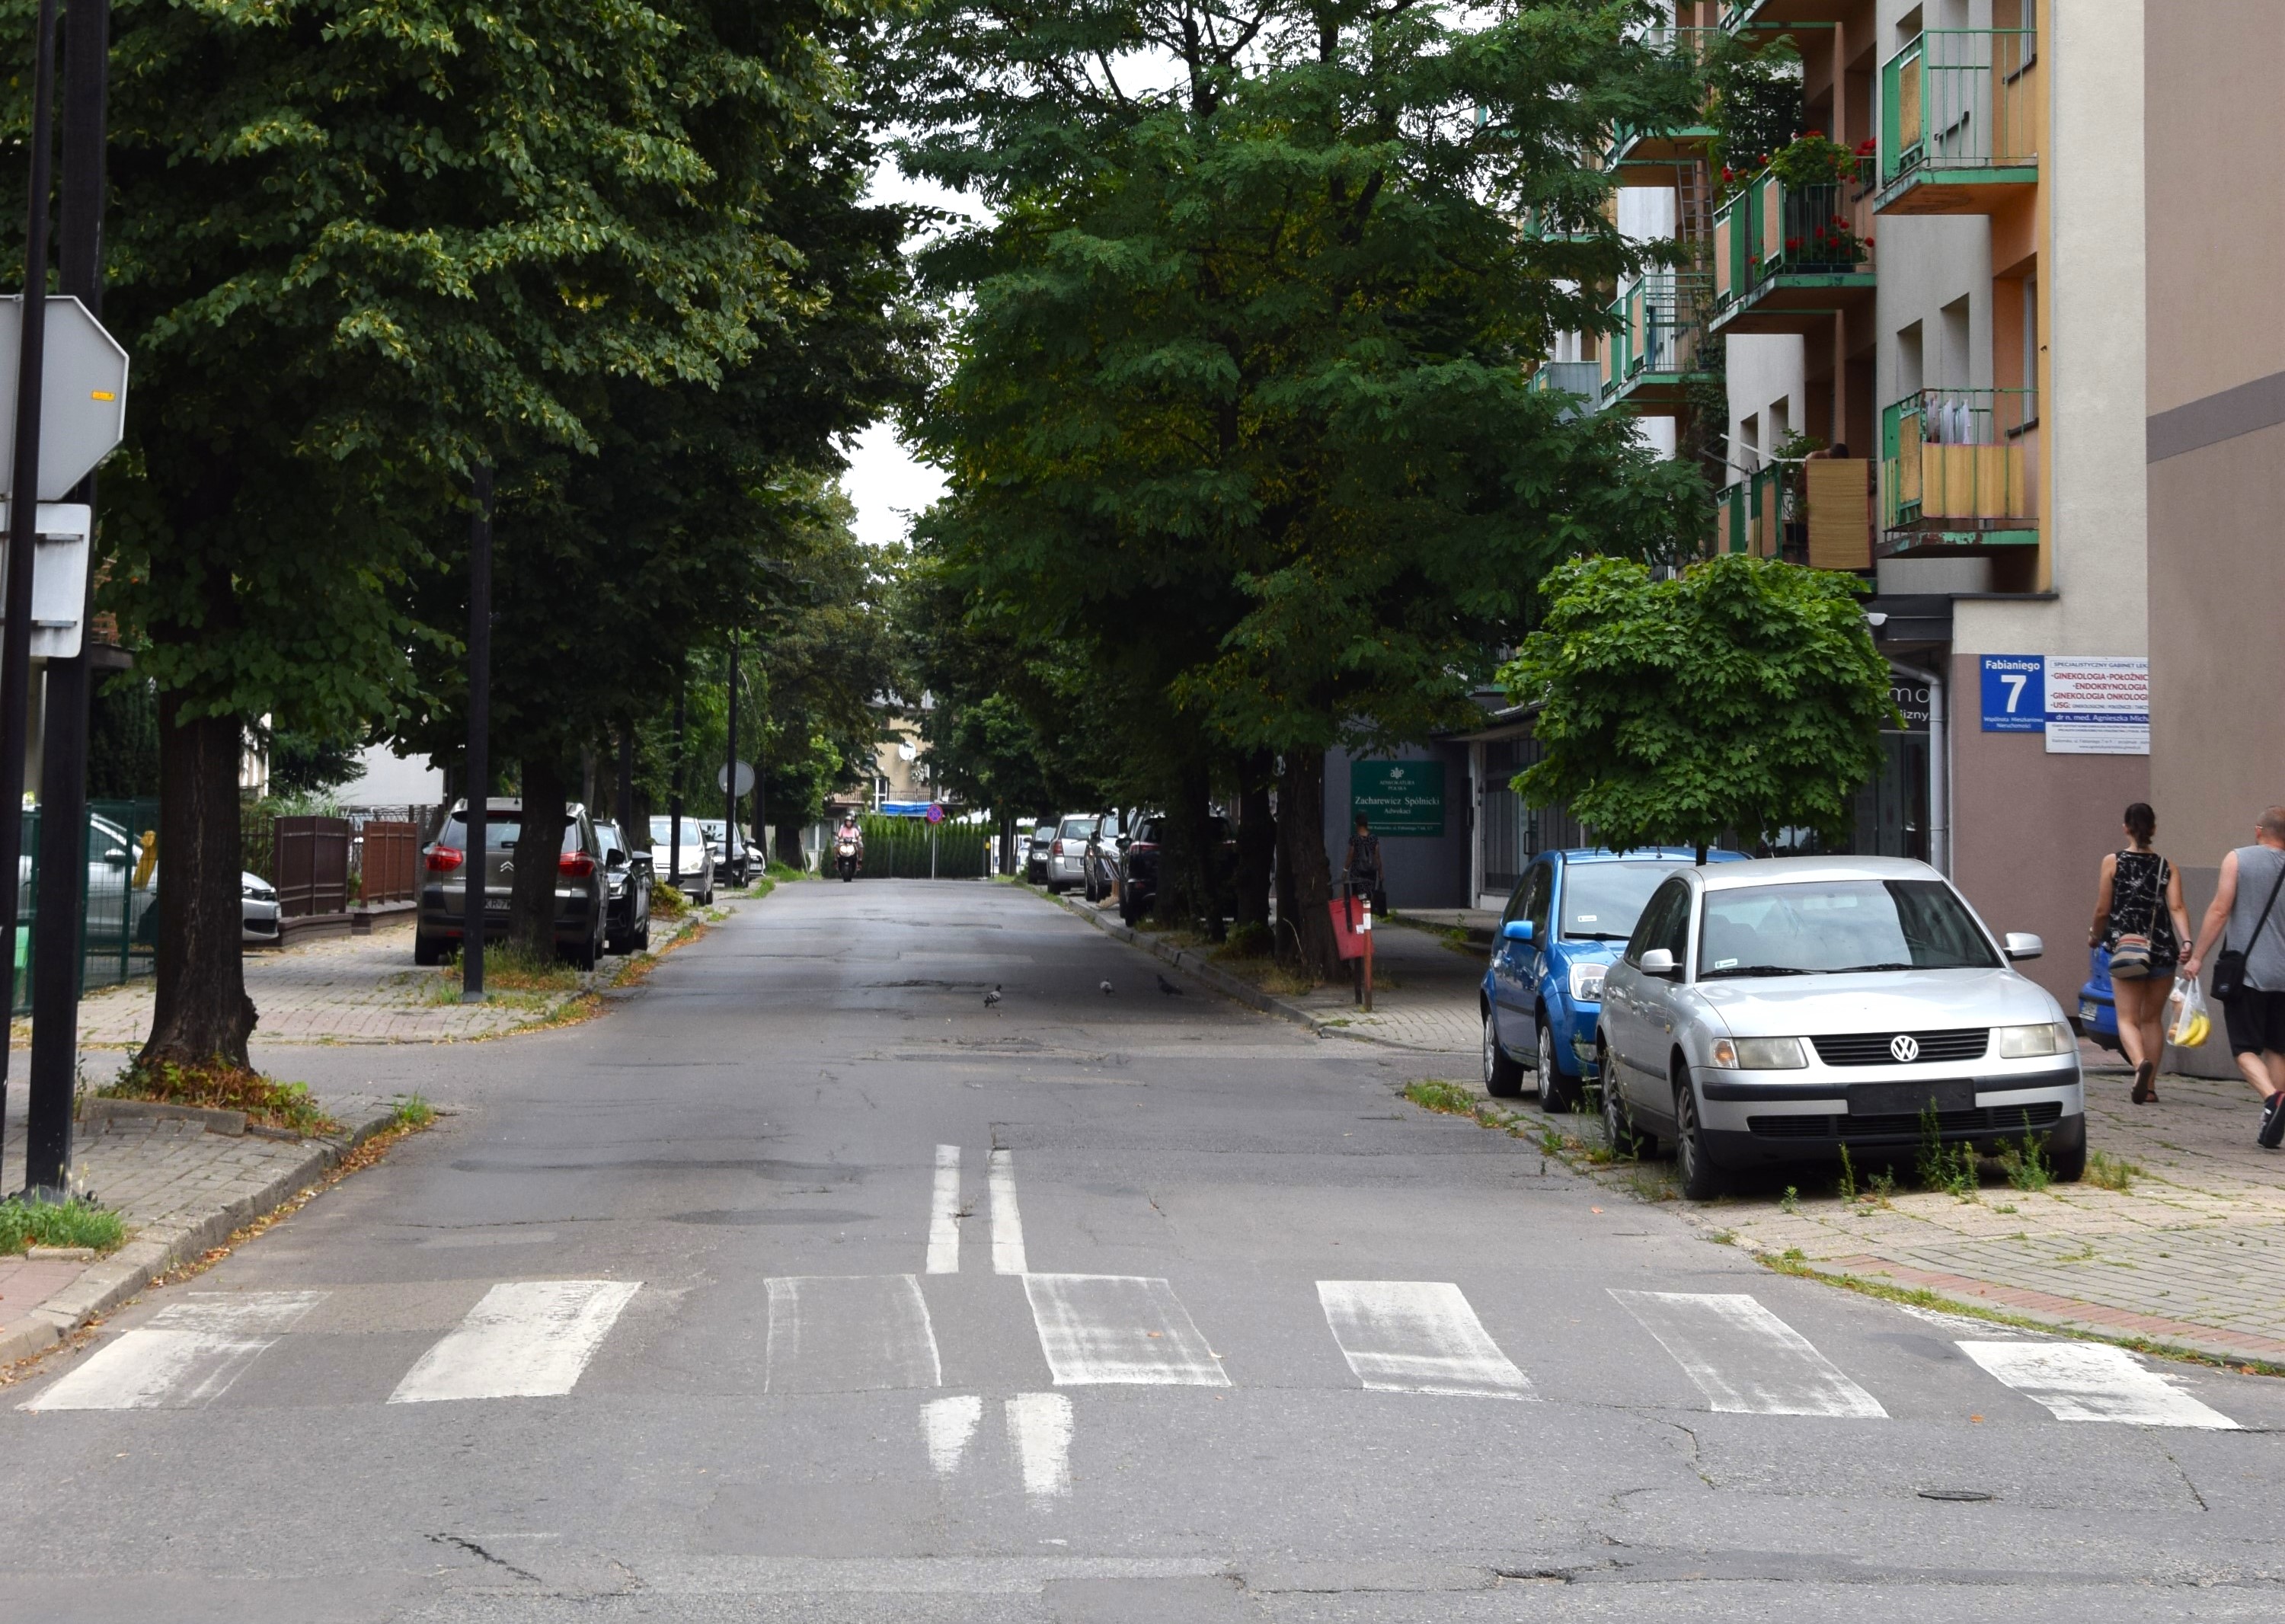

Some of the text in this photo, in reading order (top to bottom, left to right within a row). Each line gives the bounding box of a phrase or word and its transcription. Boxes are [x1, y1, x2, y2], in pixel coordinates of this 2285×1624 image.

[1985, 660, 2041, 672] Fabianiego
[2000, 675, 2027, 713] 7
[1355, 796, 1401, 805] Zacharewicz
